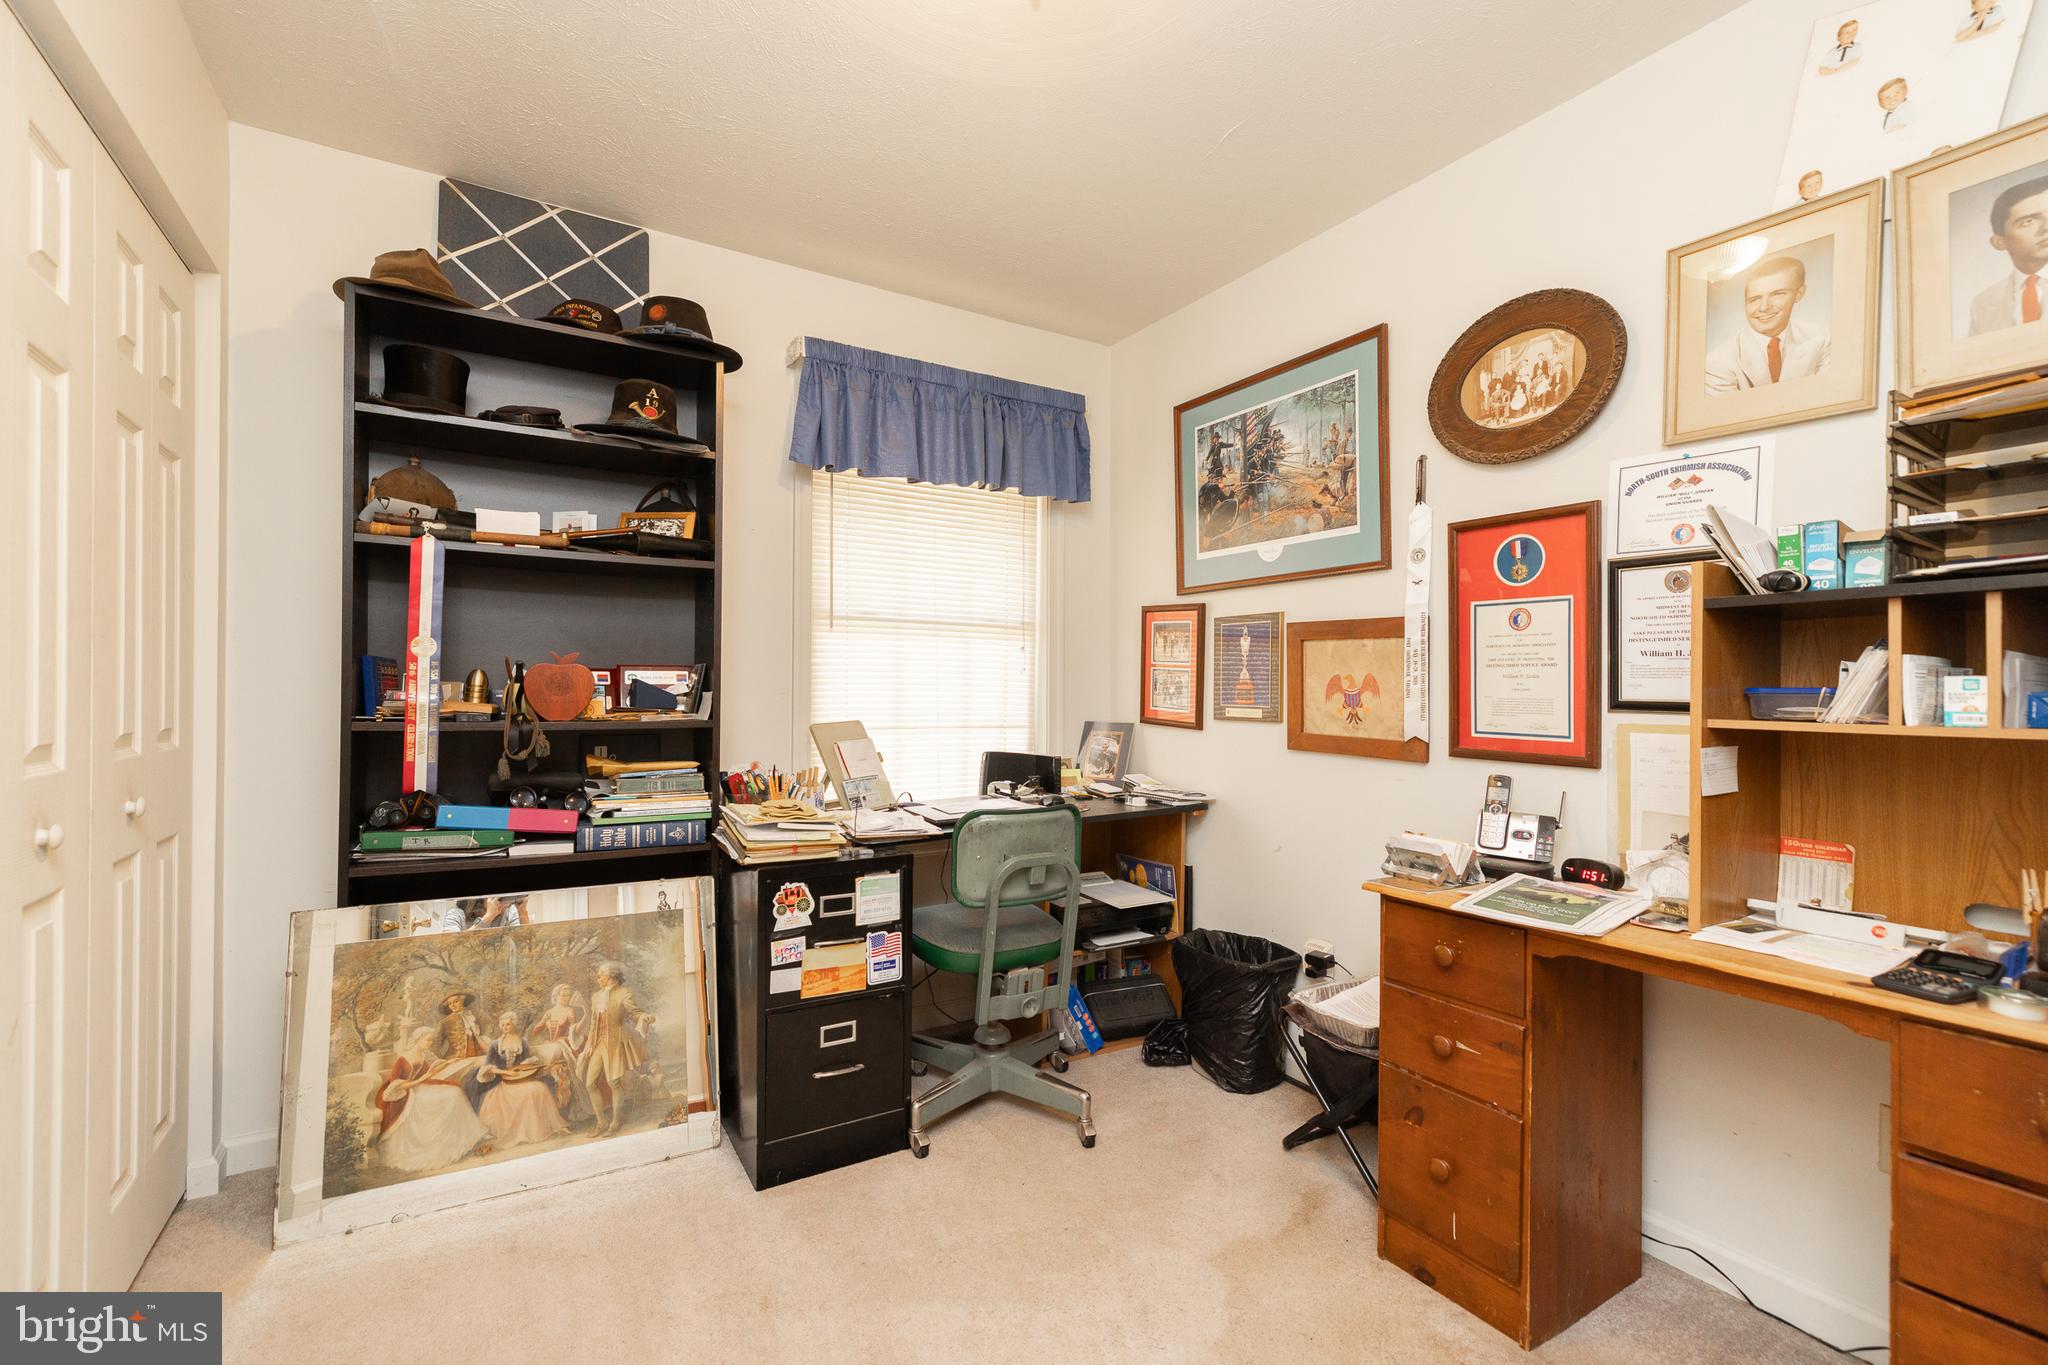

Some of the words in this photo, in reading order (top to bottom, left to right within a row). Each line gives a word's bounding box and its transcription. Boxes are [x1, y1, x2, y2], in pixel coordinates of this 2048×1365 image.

[565, 303, 596, 314] INFANTRY
[646, 388, 659, 399] A
[1625, 468, 1669, 497] NORTH-SOUTH
[1670, 463, 1706, 474] SKIRMISH
[1707, 462, 1752, 481] ASSOCIATION
[1813, 579, 1830, 589] 40
[407, 678, 417, 721] ANNIVERSARY
[406, 723, 416, 762] CELEBRATION
[600, 828, 615, 848] Holy
[614, 827, 627, 848] Bible
[1784, 839, 1800, 847] 150
[1814, 844, 1847, 852] CALENDAR
